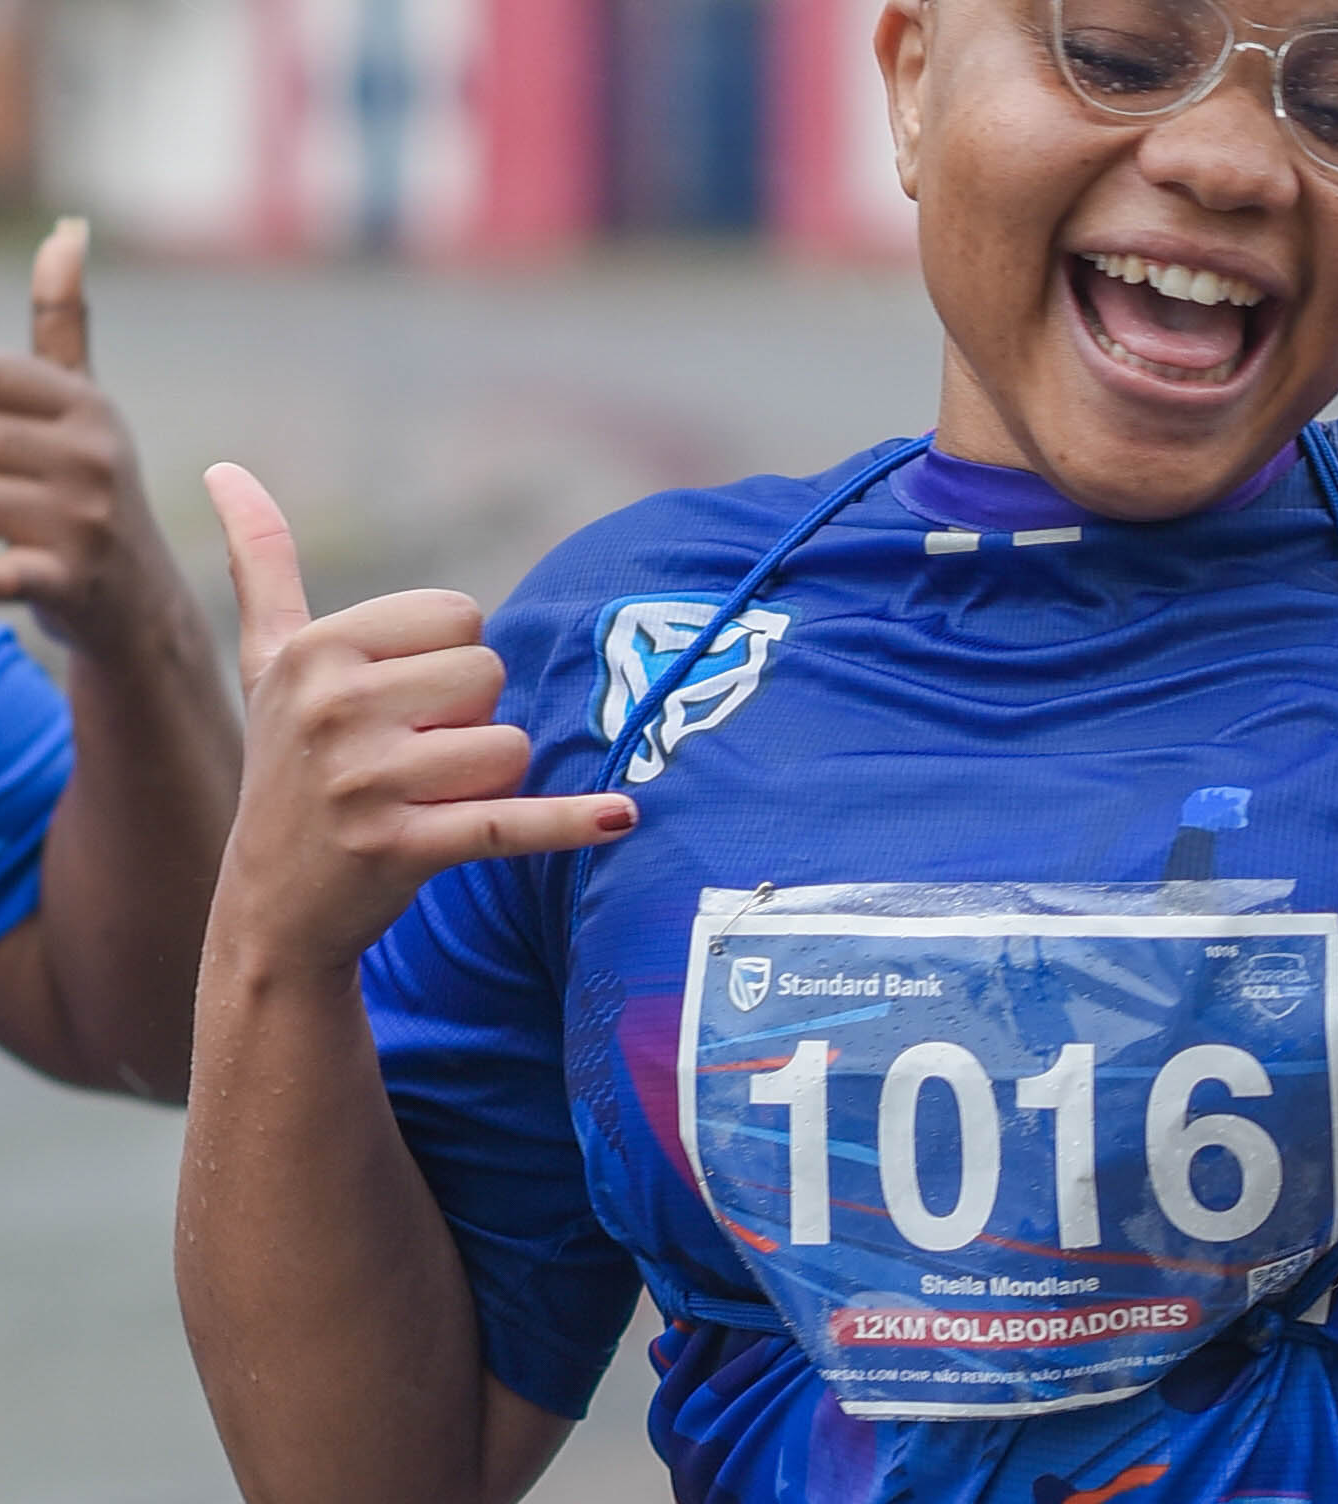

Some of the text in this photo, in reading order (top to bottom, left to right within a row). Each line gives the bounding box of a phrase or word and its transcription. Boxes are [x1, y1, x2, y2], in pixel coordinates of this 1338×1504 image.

[777, 972, 944, 997] Standard Bank
[749, 1040, 1283, 1252] 1016
[920, 1274, 1101, 1296] Sheila Mondlane
[853, 1303, 1189, 1343] 12KM COLABORADORES
